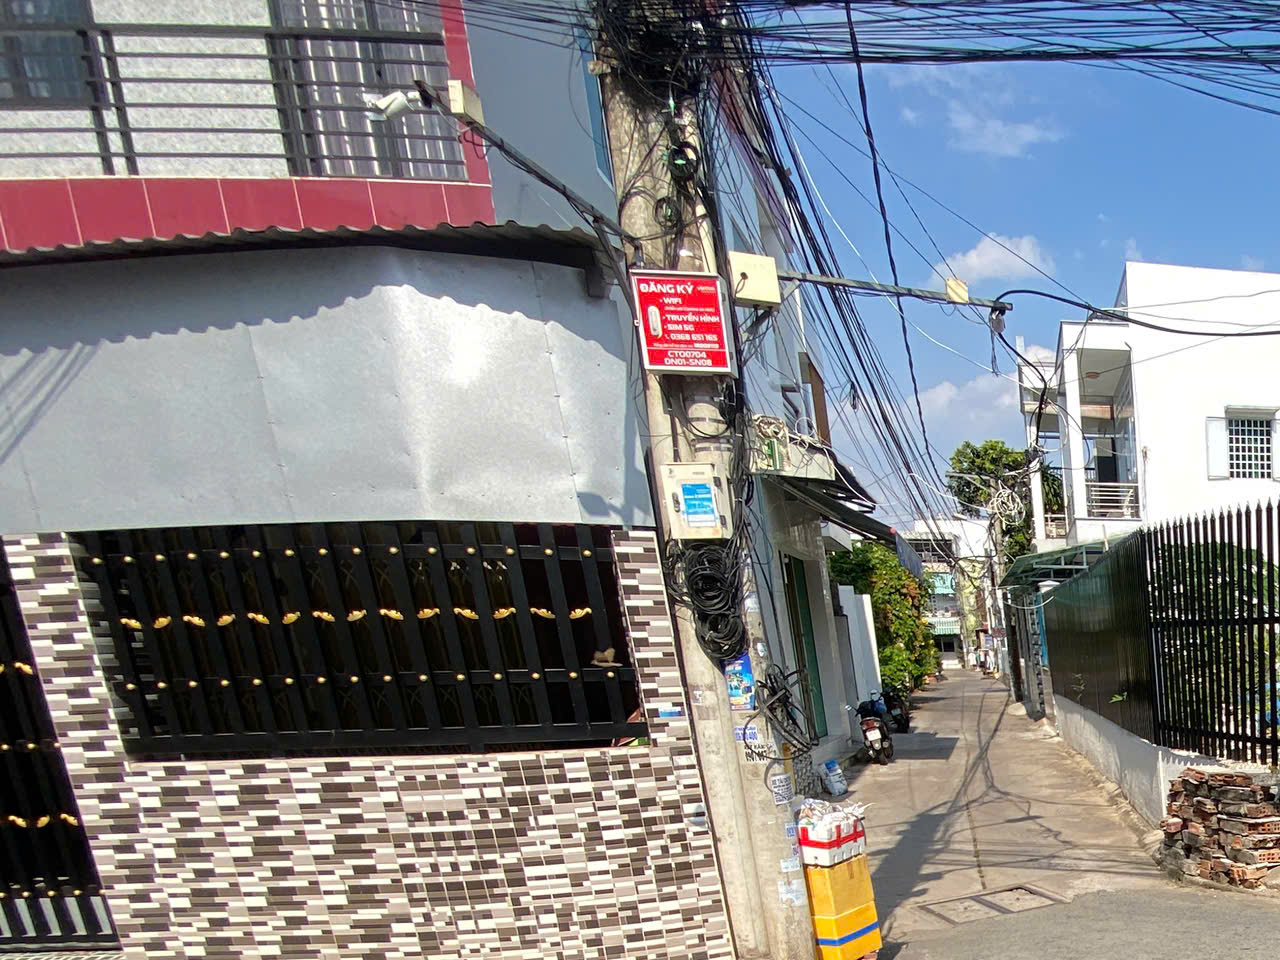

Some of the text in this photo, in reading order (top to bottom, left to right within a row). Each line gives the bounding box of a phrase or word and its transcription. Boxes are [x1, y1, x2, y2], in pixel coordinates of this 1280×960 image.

[640, 281, 694, 294] ĐĂNG KÝ
[665, 312, 720, 323] TRUYỀN HÌNH
